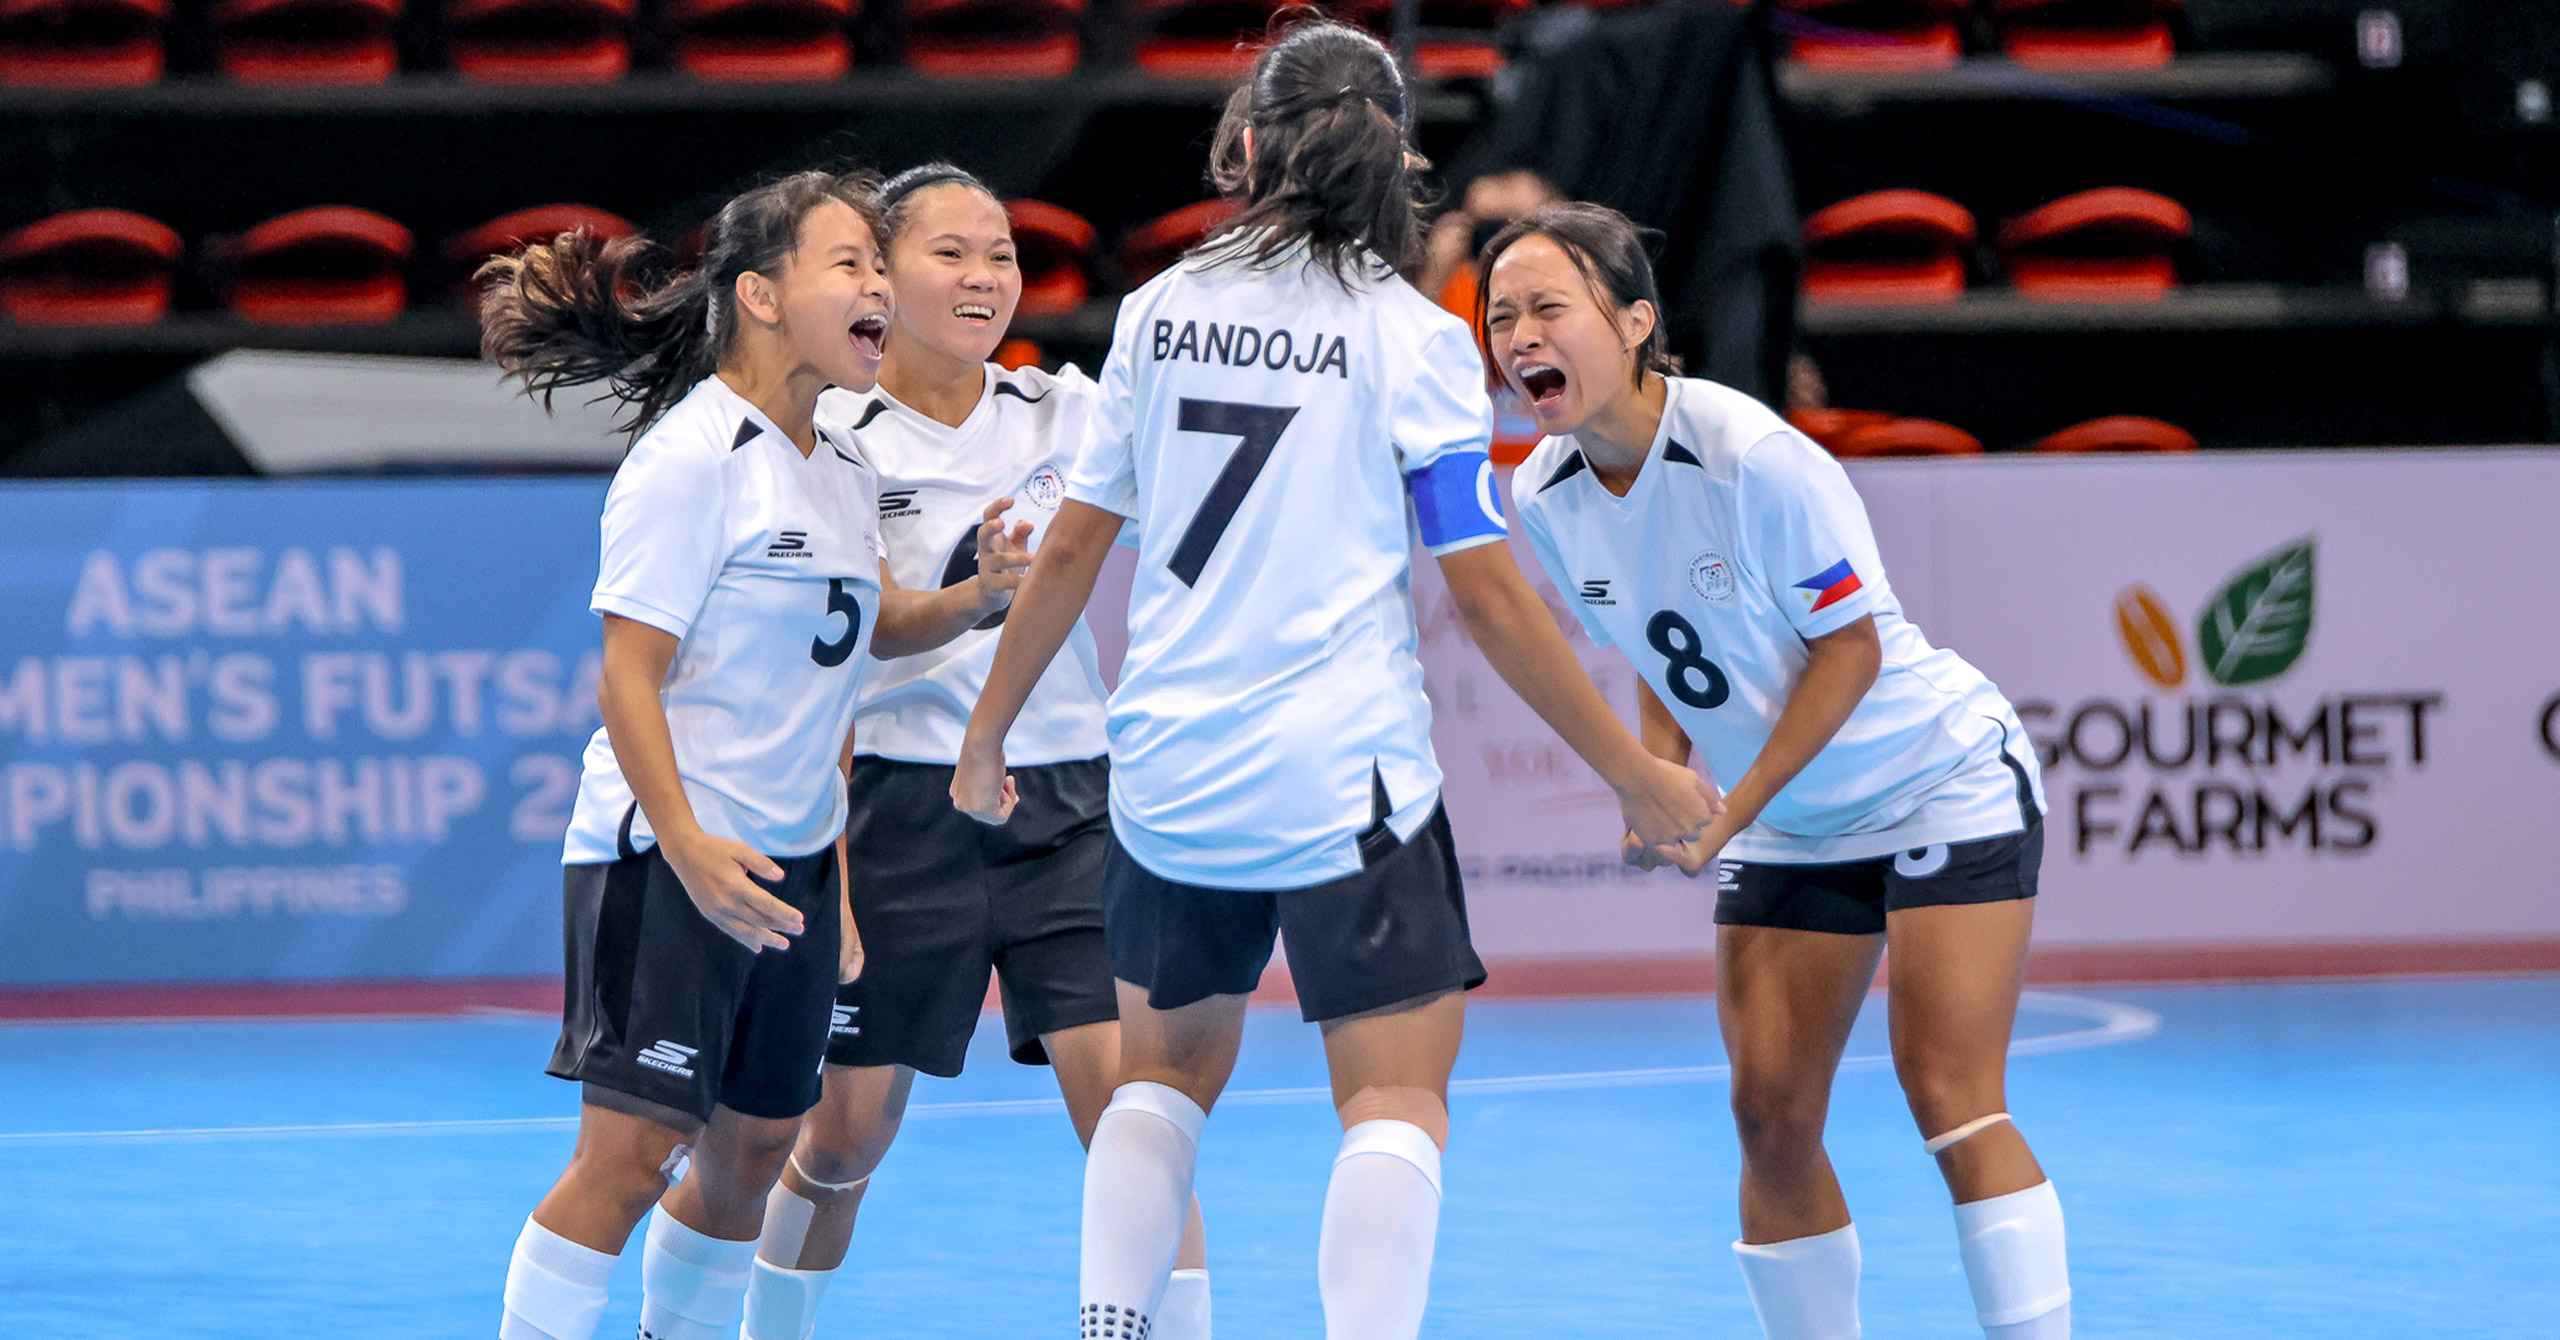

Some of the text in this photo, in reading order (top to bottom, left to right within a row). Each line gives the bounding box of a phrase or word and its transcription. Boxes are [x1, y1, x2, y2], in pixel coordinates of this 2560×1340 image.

[1153, 318, 1350, 379] BANDOJA
[1166, 396, 1302, 590] 7
[68, 547, 405, 637] ASEAN
[810, 577, 862, 669] 5
[1646, 609, 1731, 710] 8
[2073, 780, 2378, 861] FARMS
[87, 863, 407, 920] PHILIPPINES
[636, 1055, 694, 1077] SKECHERS
